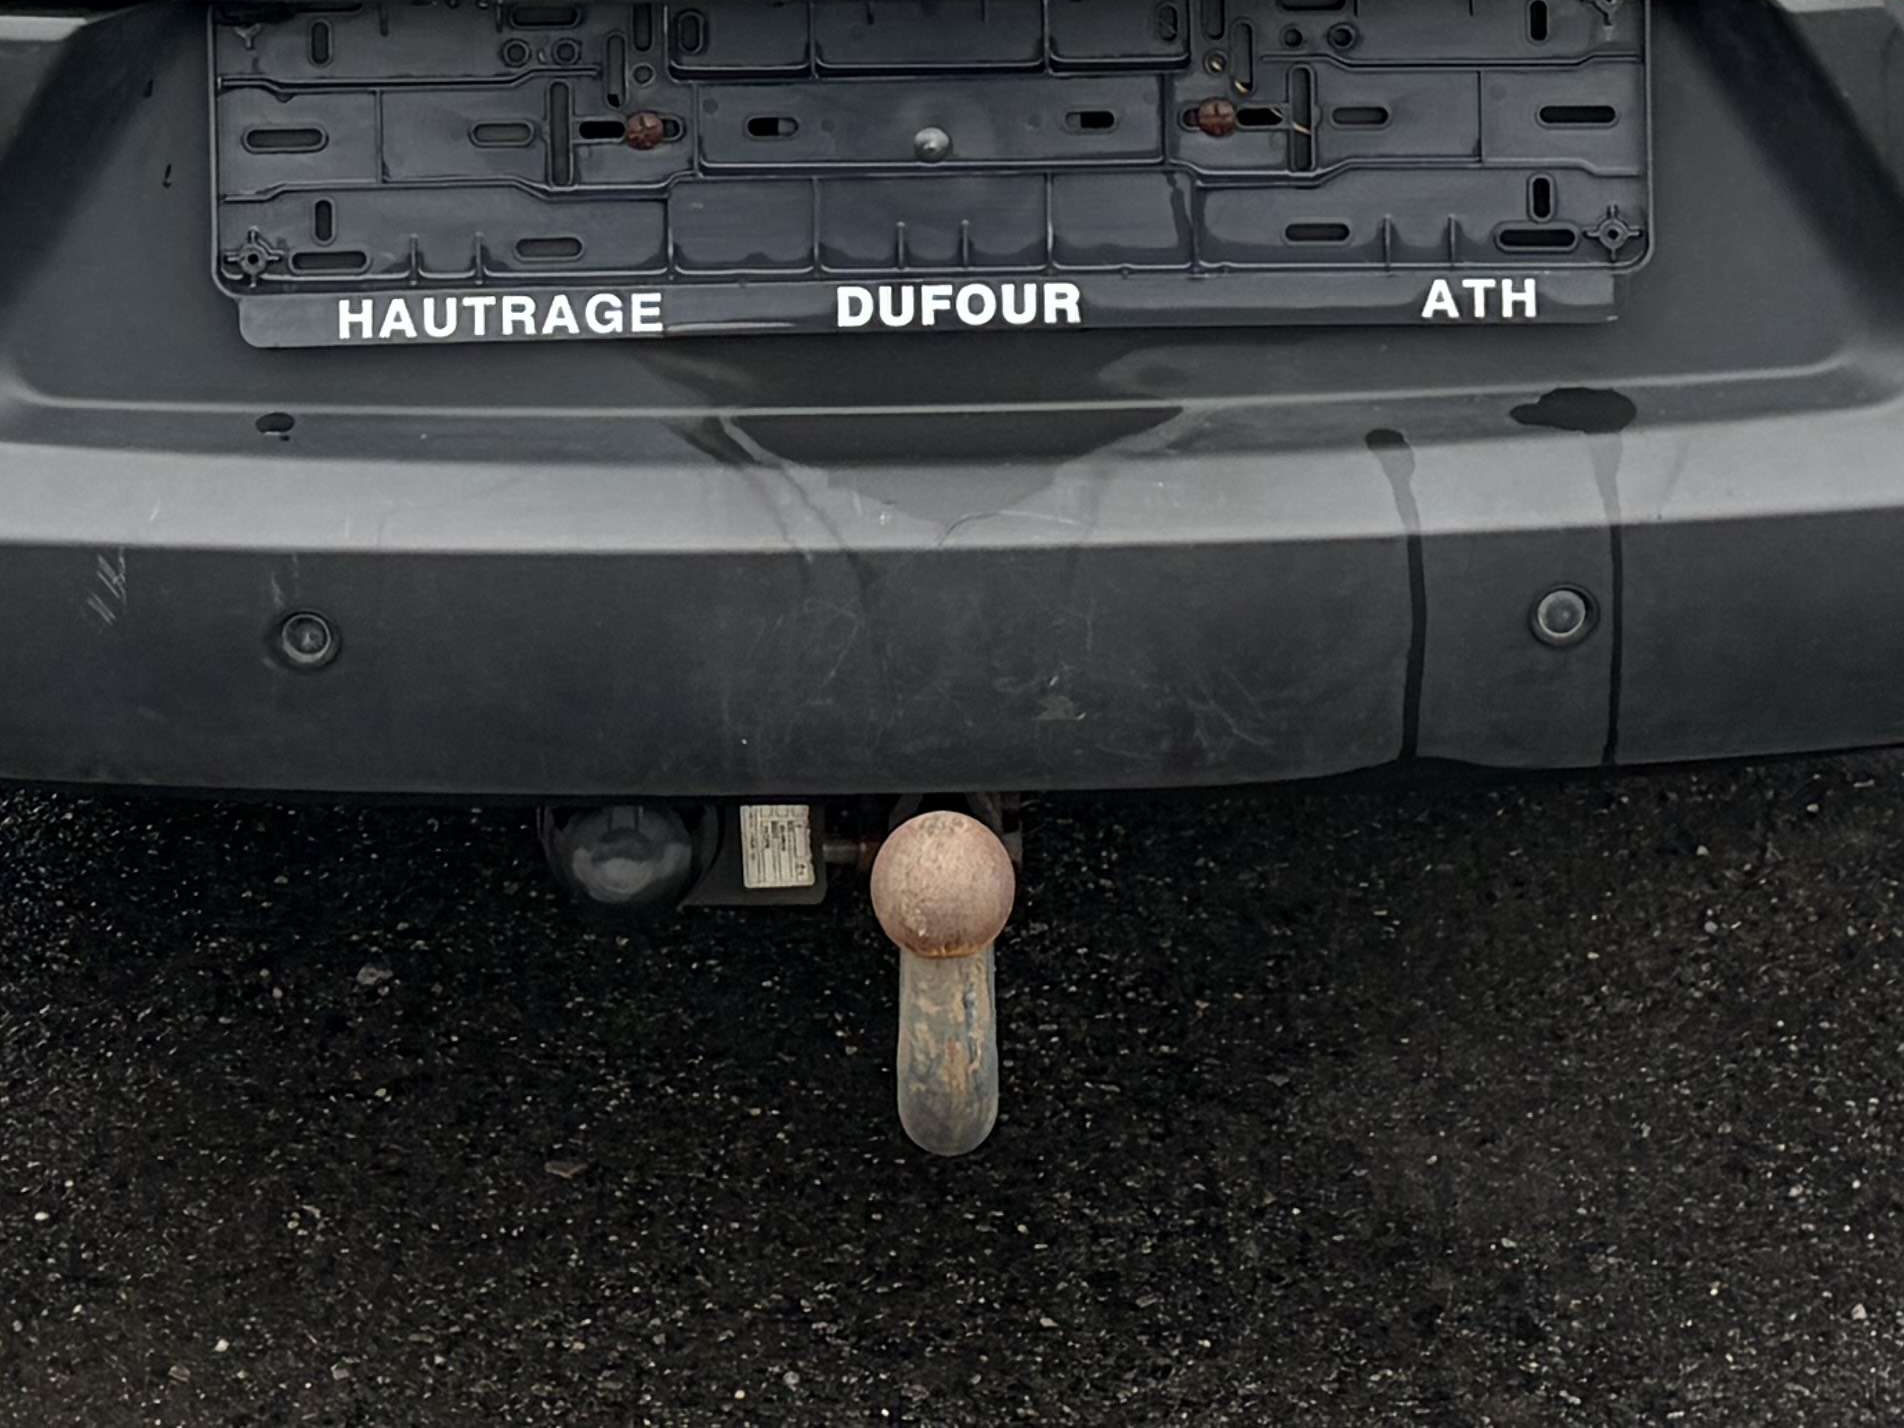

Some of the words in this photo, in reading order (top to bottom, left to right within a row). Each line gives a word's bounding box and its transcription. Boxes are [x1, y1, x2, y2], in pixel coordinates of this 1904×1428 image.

[337, 292, 663, 339] HAUTRAGE
[836, 282, 1081, 327] DUFOUR
[1422, 279, 1538, 319] ATH
